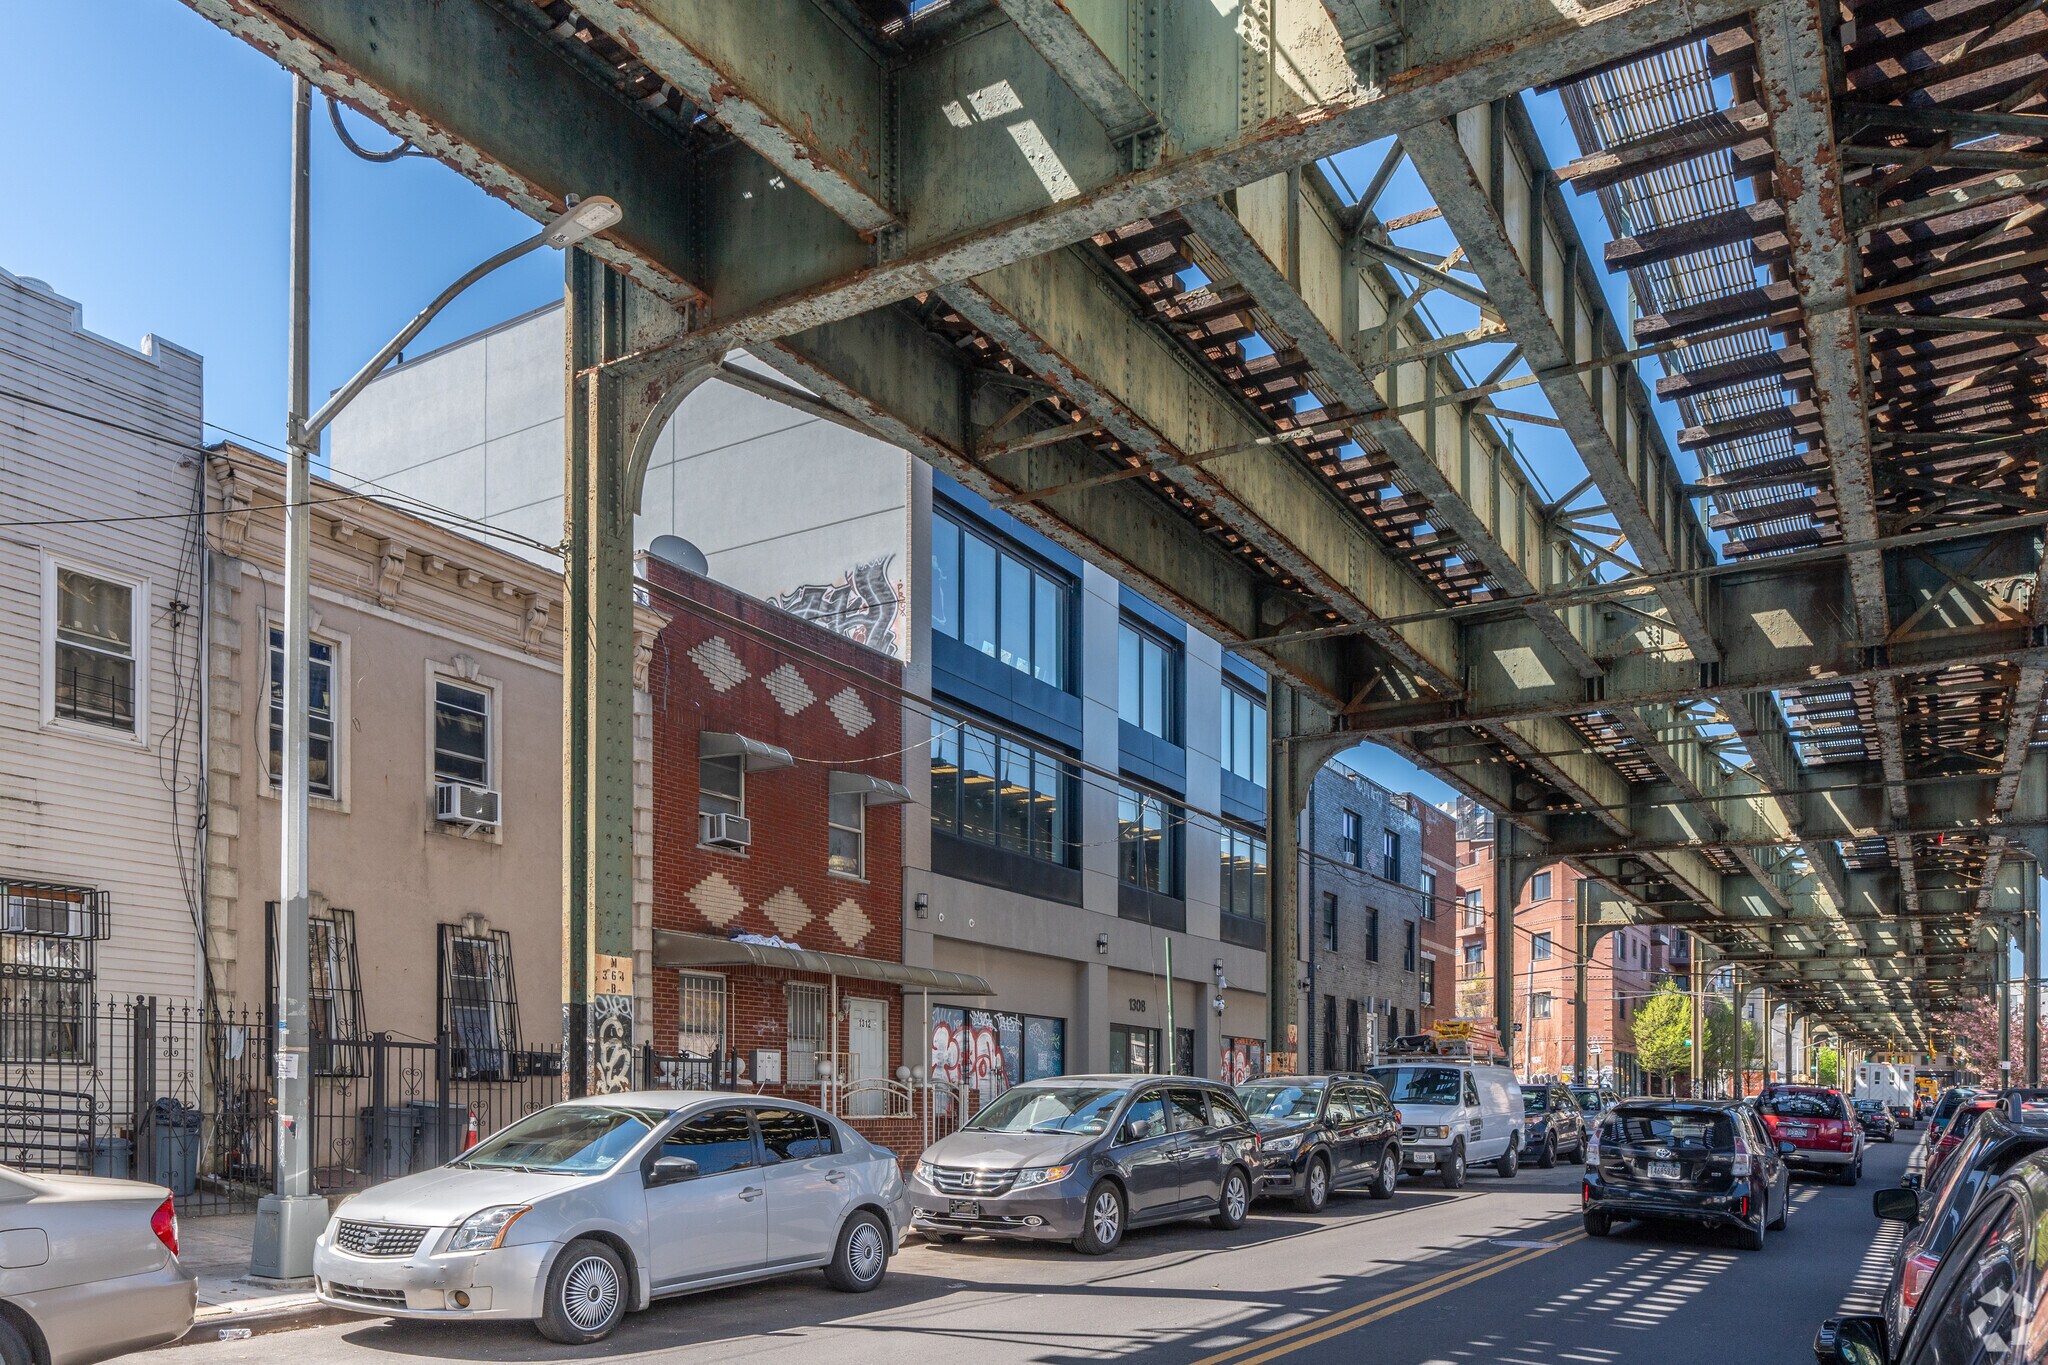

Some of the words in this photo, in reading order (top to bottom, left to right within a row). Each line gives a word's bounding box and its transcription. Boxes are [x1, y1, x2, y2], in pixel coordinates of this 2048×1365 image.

[602, 970, 625, 982] 364
[610, 983, 617, 994] B
[1128, 997, 1146, 1013] 1308
[858, 1018, 872, 1029] 1312
